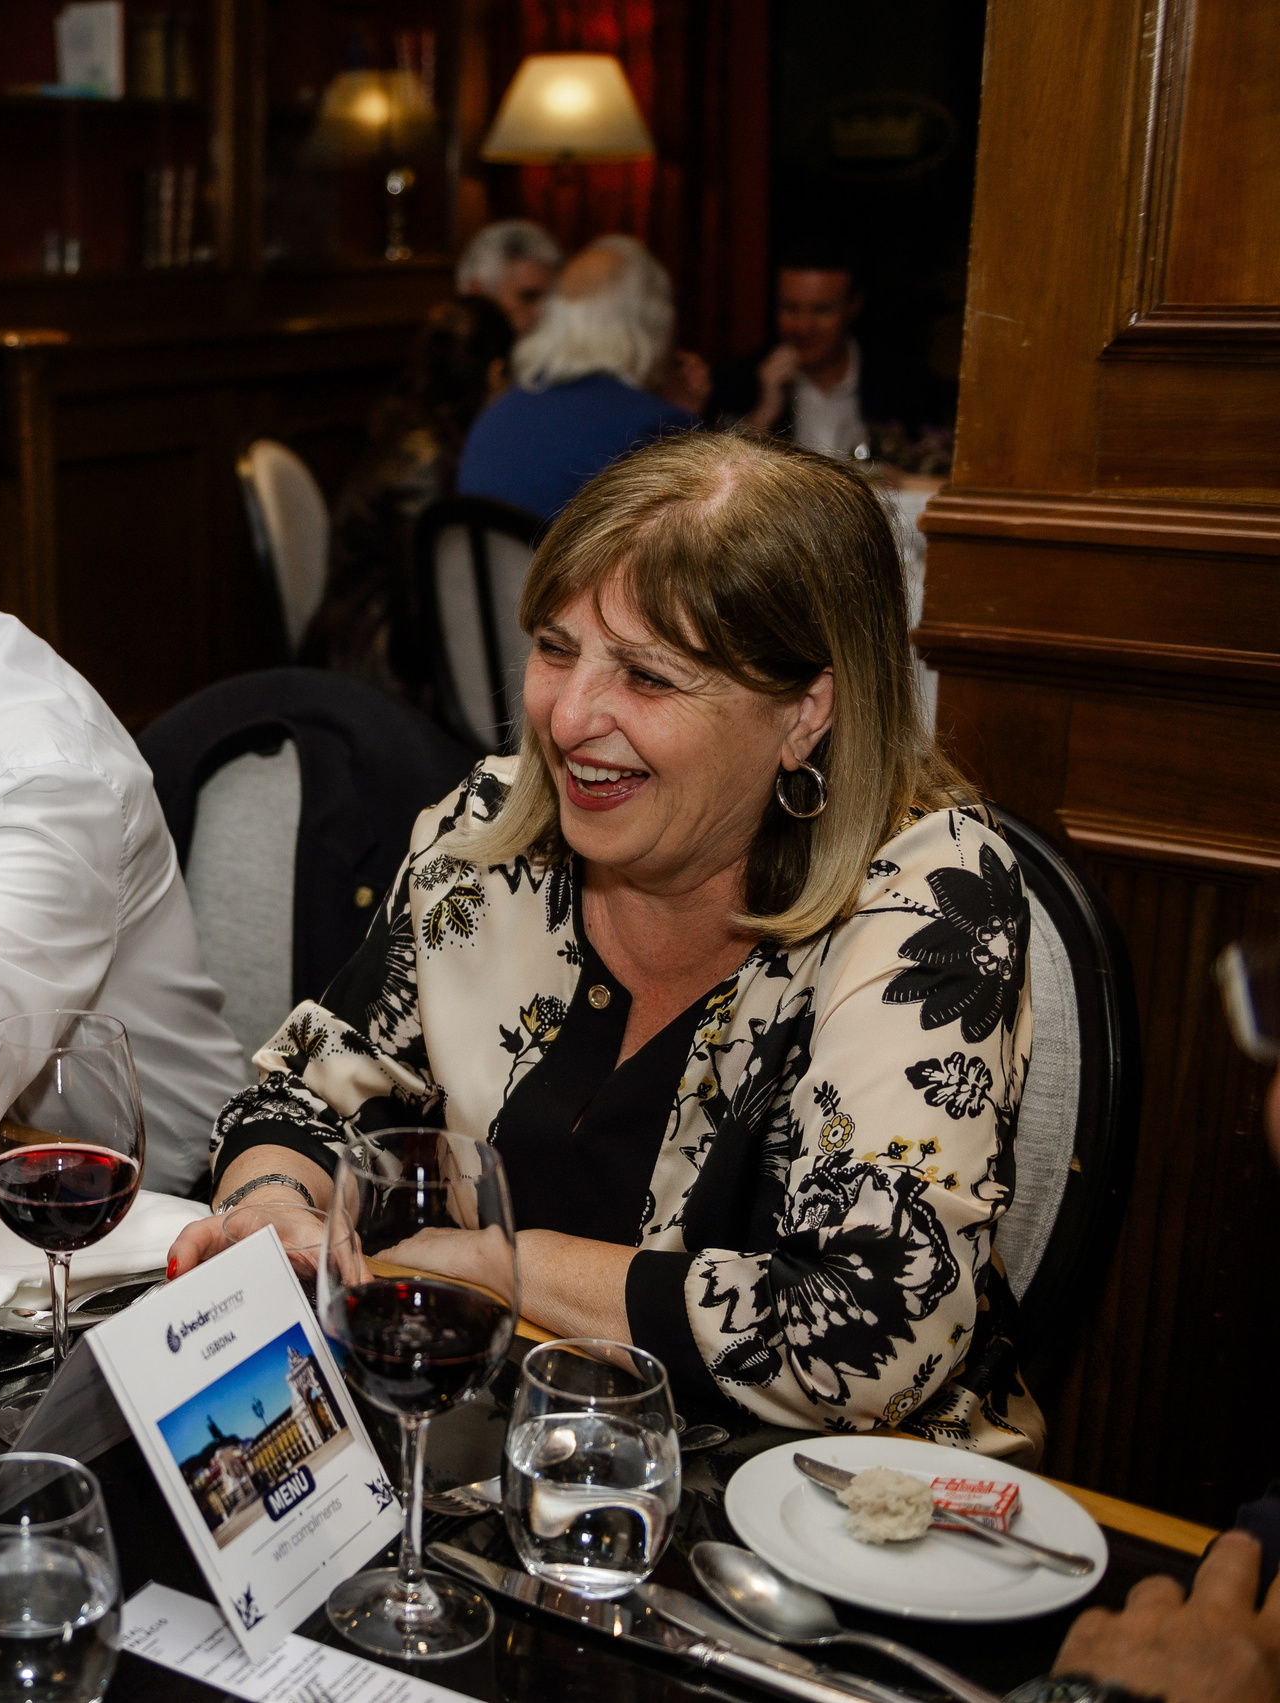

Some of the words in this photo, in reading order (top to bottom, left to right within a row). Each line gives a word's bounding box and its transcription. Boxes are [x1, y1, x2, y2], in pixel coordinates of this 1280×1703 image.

[201, 1331, 237, 1360] LISBONA
[272, 1540, 292, 1561] with
[290, 1498, 343, 1547] compliments
